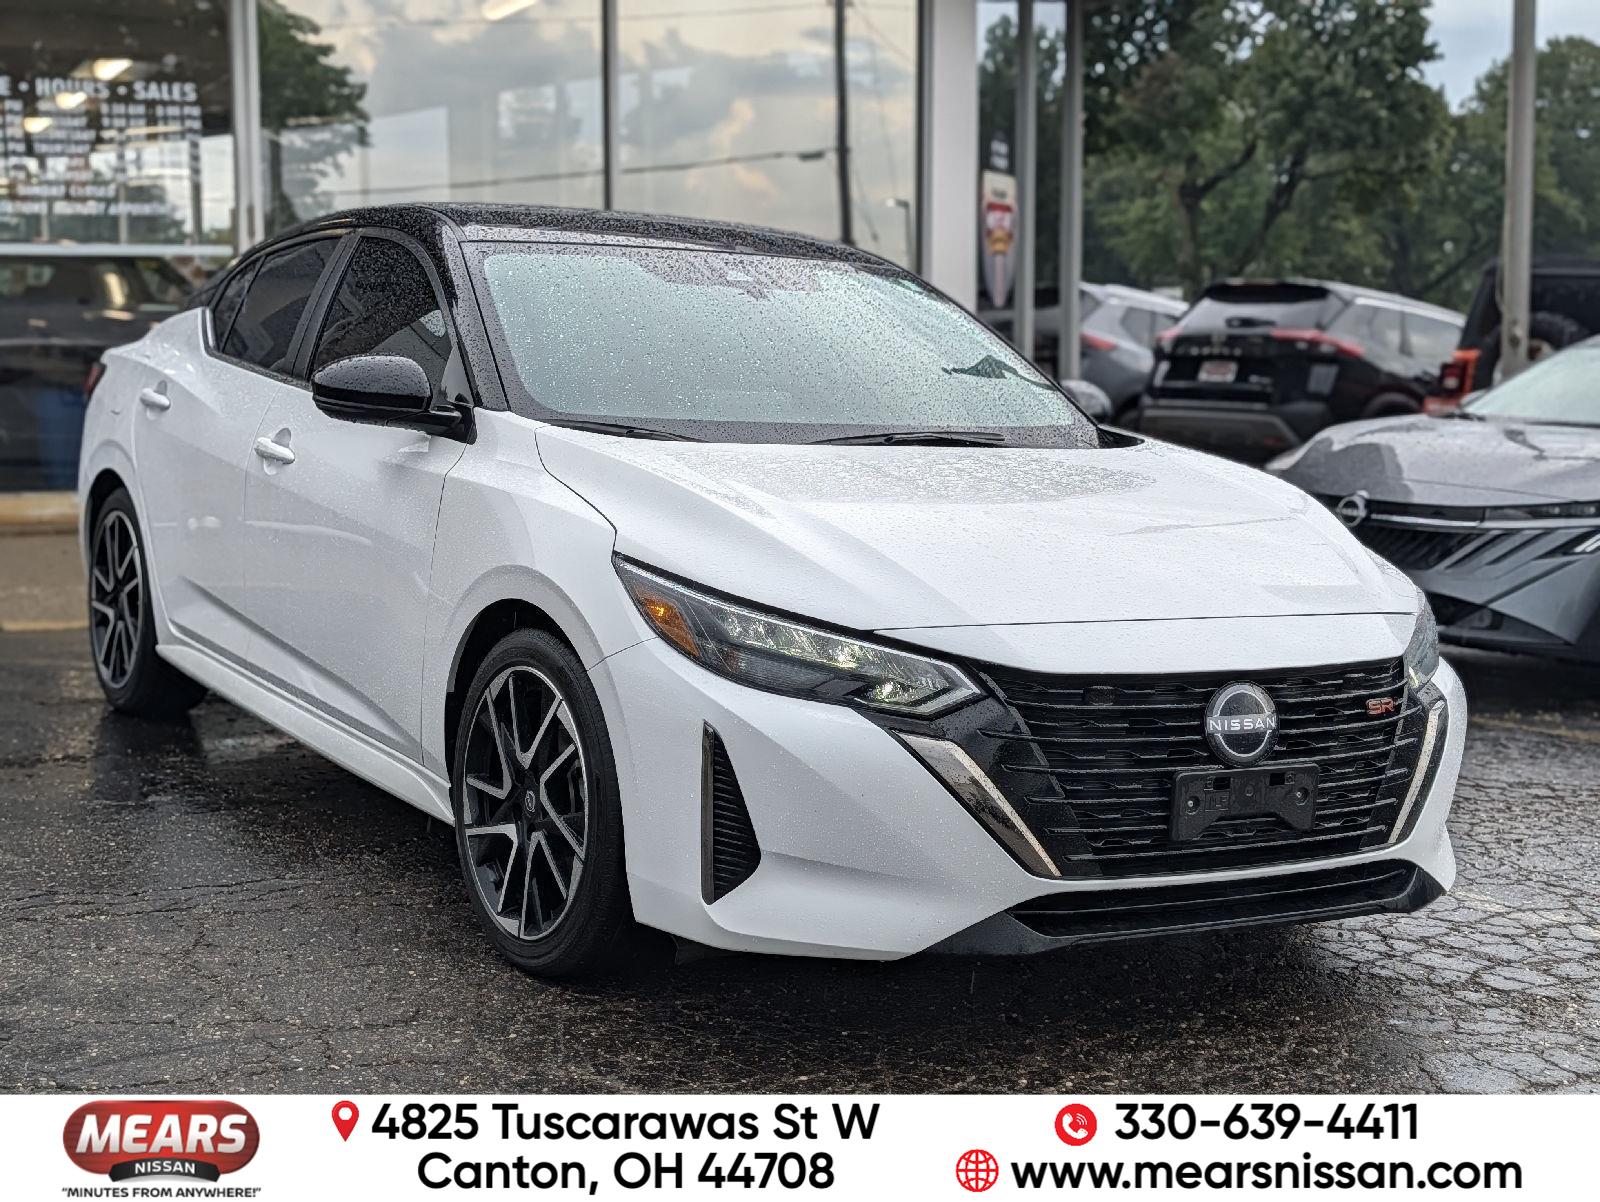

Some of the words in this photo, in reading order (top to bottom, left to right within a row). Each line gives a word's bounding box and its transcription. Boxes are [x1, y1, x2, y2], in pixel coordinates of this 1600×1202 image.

[35, 77, 110, 98] HOURS
[133, 80, 198, 102] SALES
[1365, 697, 1395, 716] SR
[1209, 715, 1277, 731] NISSAN
